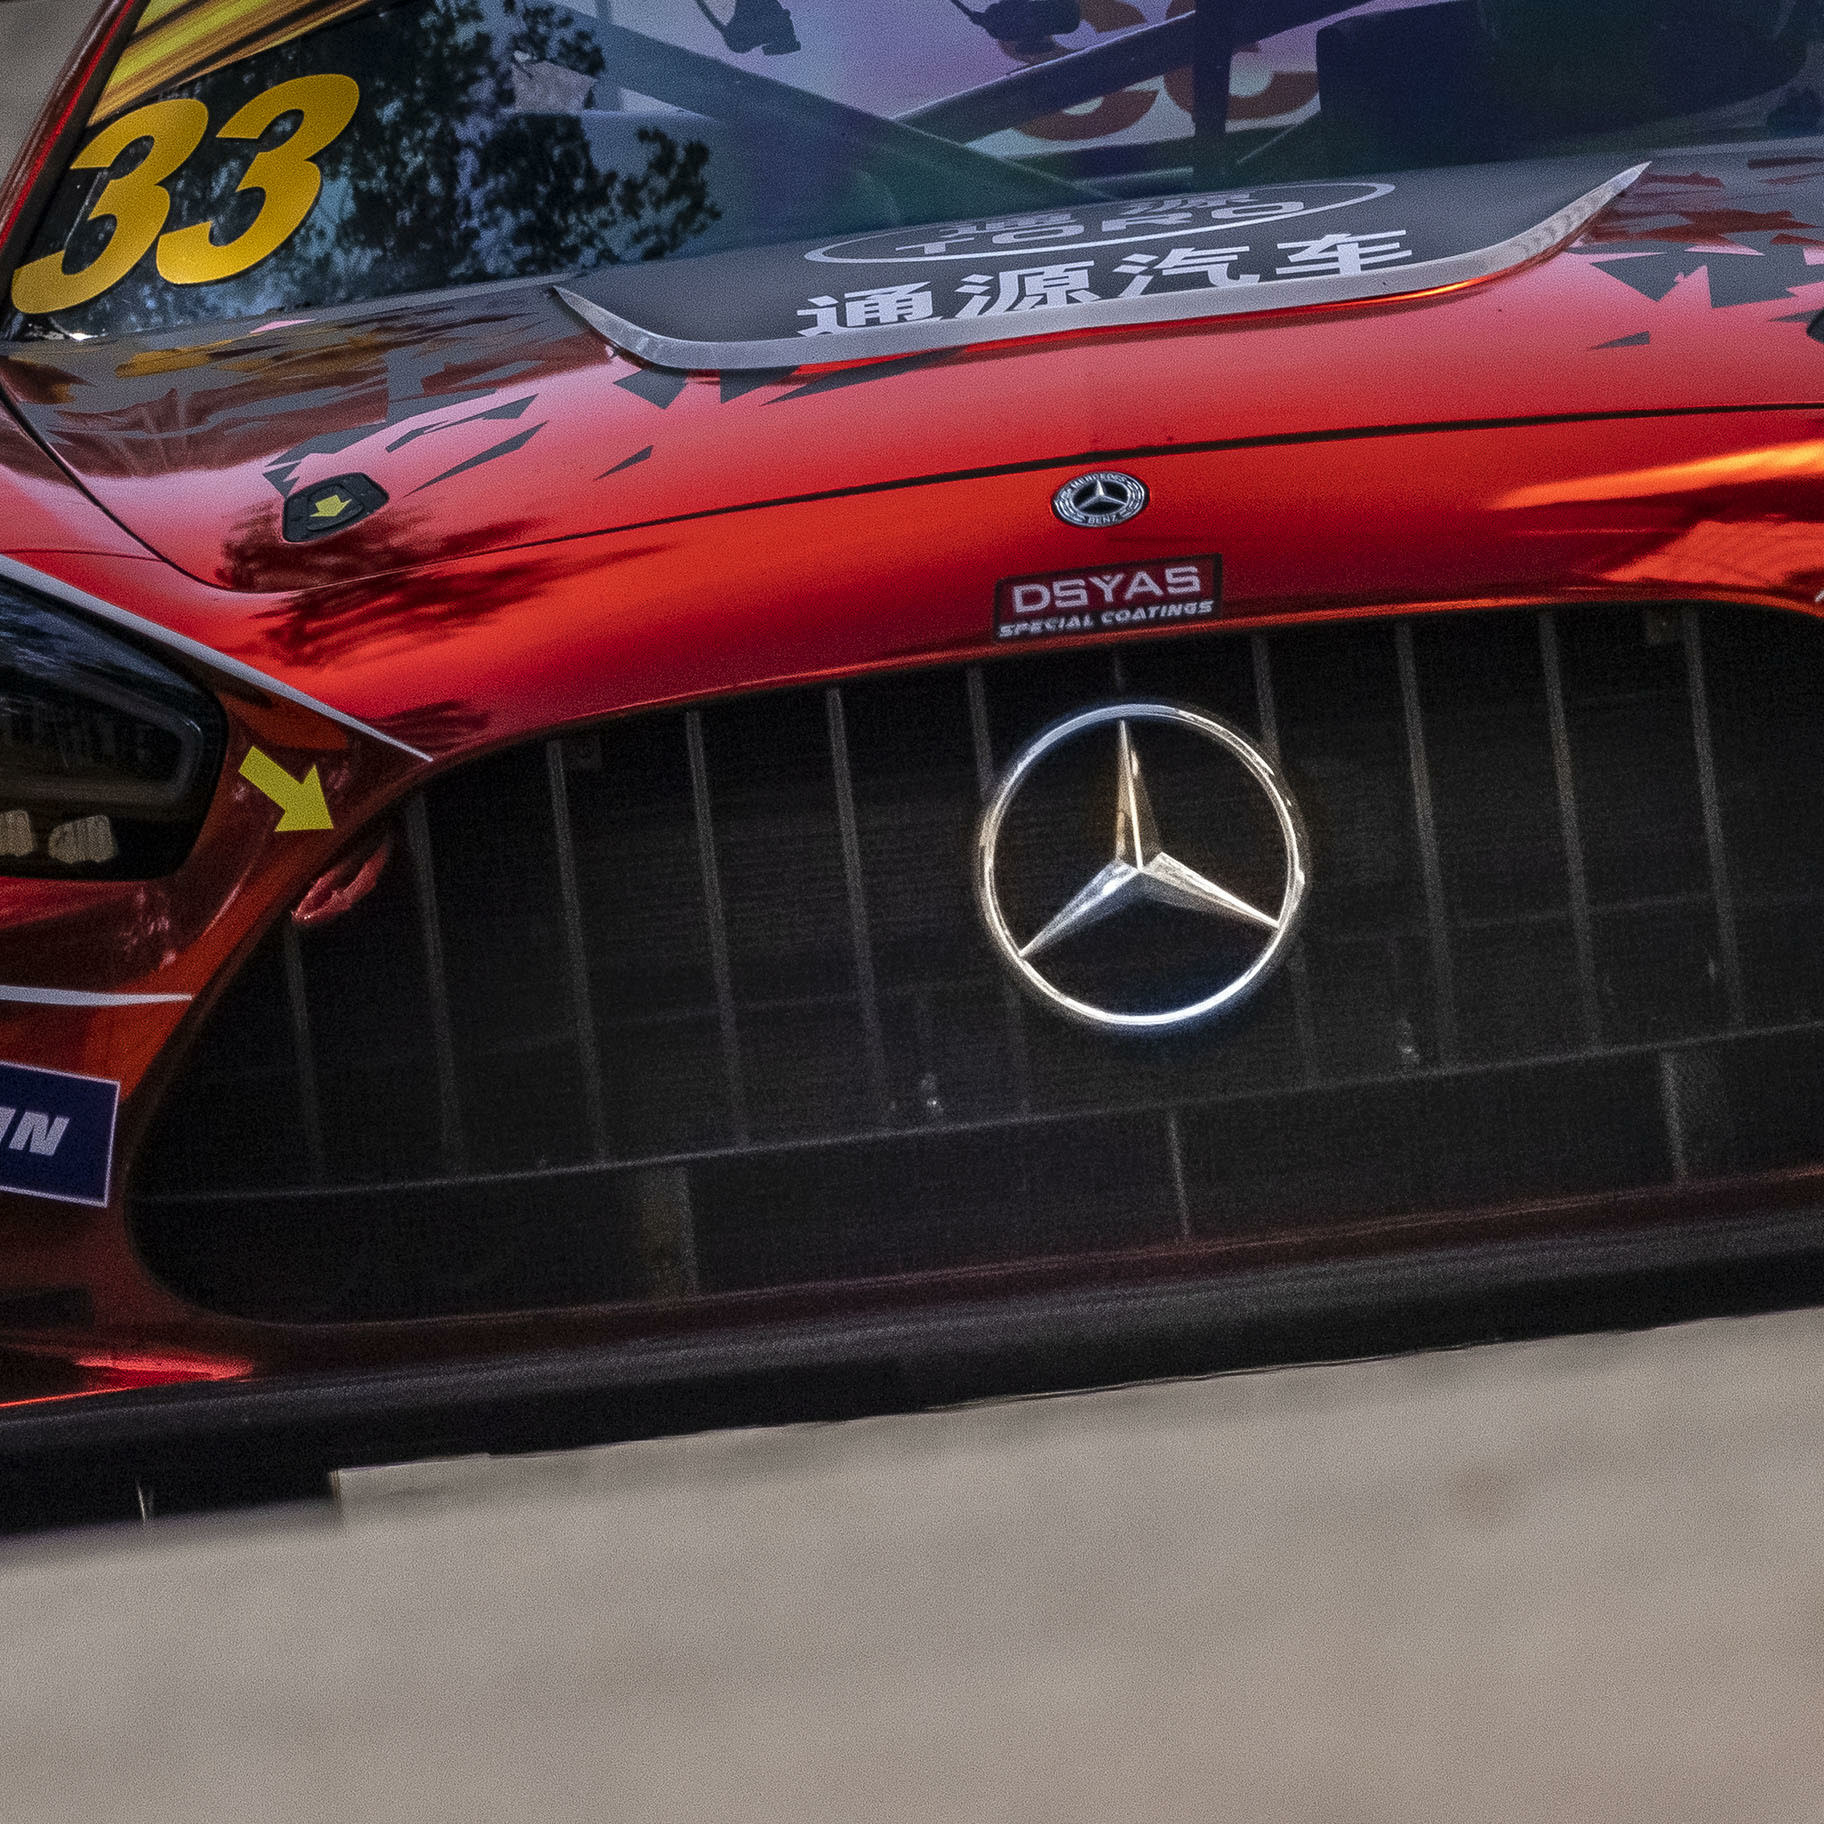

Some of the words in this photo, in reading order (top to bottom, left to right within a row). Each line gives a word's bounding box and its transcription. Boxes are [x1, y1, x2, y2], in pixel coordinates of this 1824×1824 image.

[11, 73, 360, 315] 33
[796, 229, 1413, 338] 通源汽车
[998, 614, 1094, 639] SPECIAL
[1100, 600, 1215, 626] COATINGS
[1013, 565, 1201, 614] DSYAS
